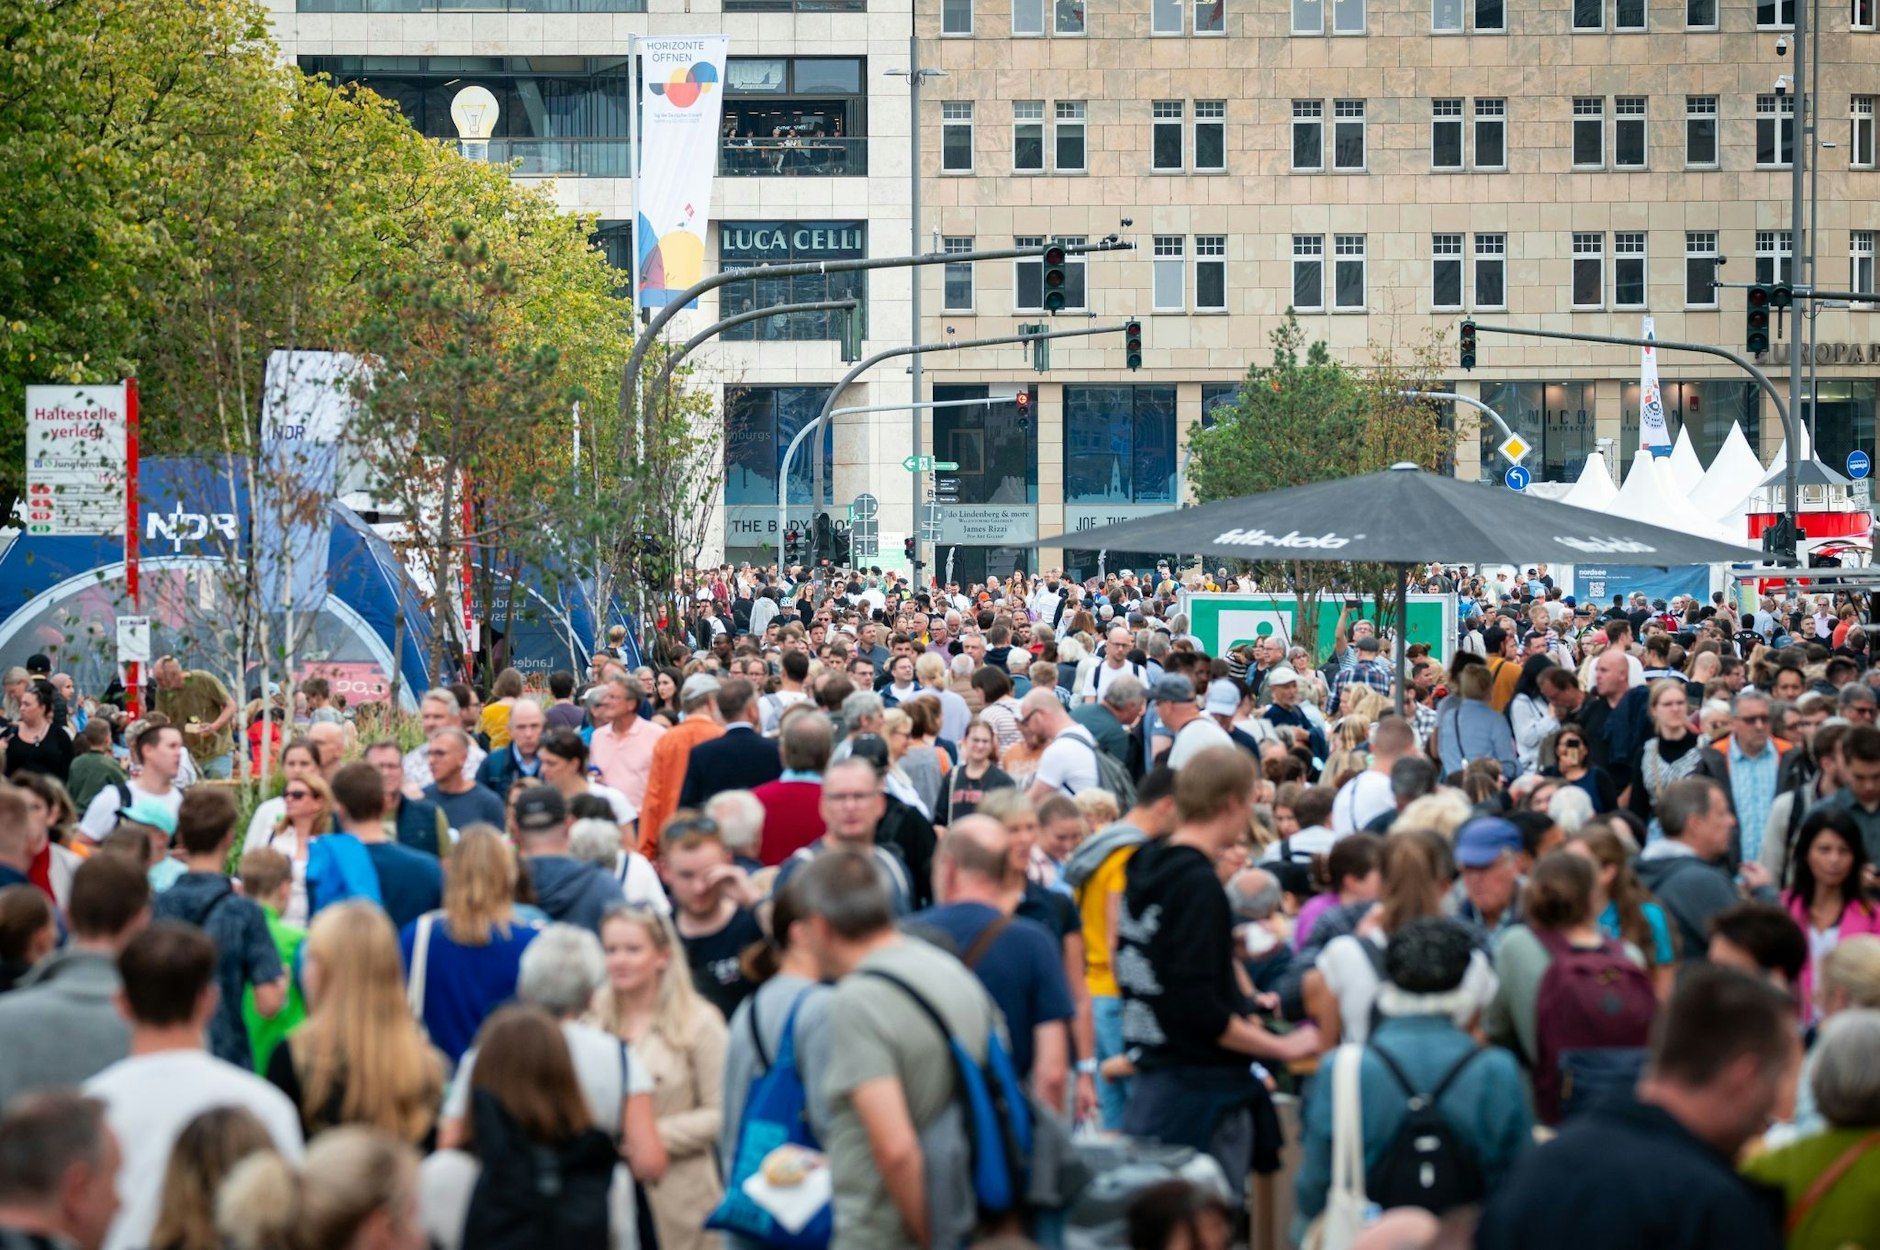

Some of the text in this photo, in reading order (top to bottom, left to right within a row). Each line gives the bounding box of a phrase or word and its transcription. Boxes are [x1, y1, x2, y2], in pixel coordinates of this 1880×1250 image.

[646, 41, 705, 51] HORIZONTE
[652, 50, 692, 62] ÖFFNEN
[723, 229, 862, 250] LUCA CELLI
[34, 408, 117, 421] Haltestelle
[272, 425, 306, 440] NDR
[960, 510, 1000, 520] Lindenberg
[1001, 510, 1010, 518] &
[146, 510, 241, 541] NDR
[733, 520, 809, 532] THE BDY
[963, 525, 1008, 533] James Rizzi
